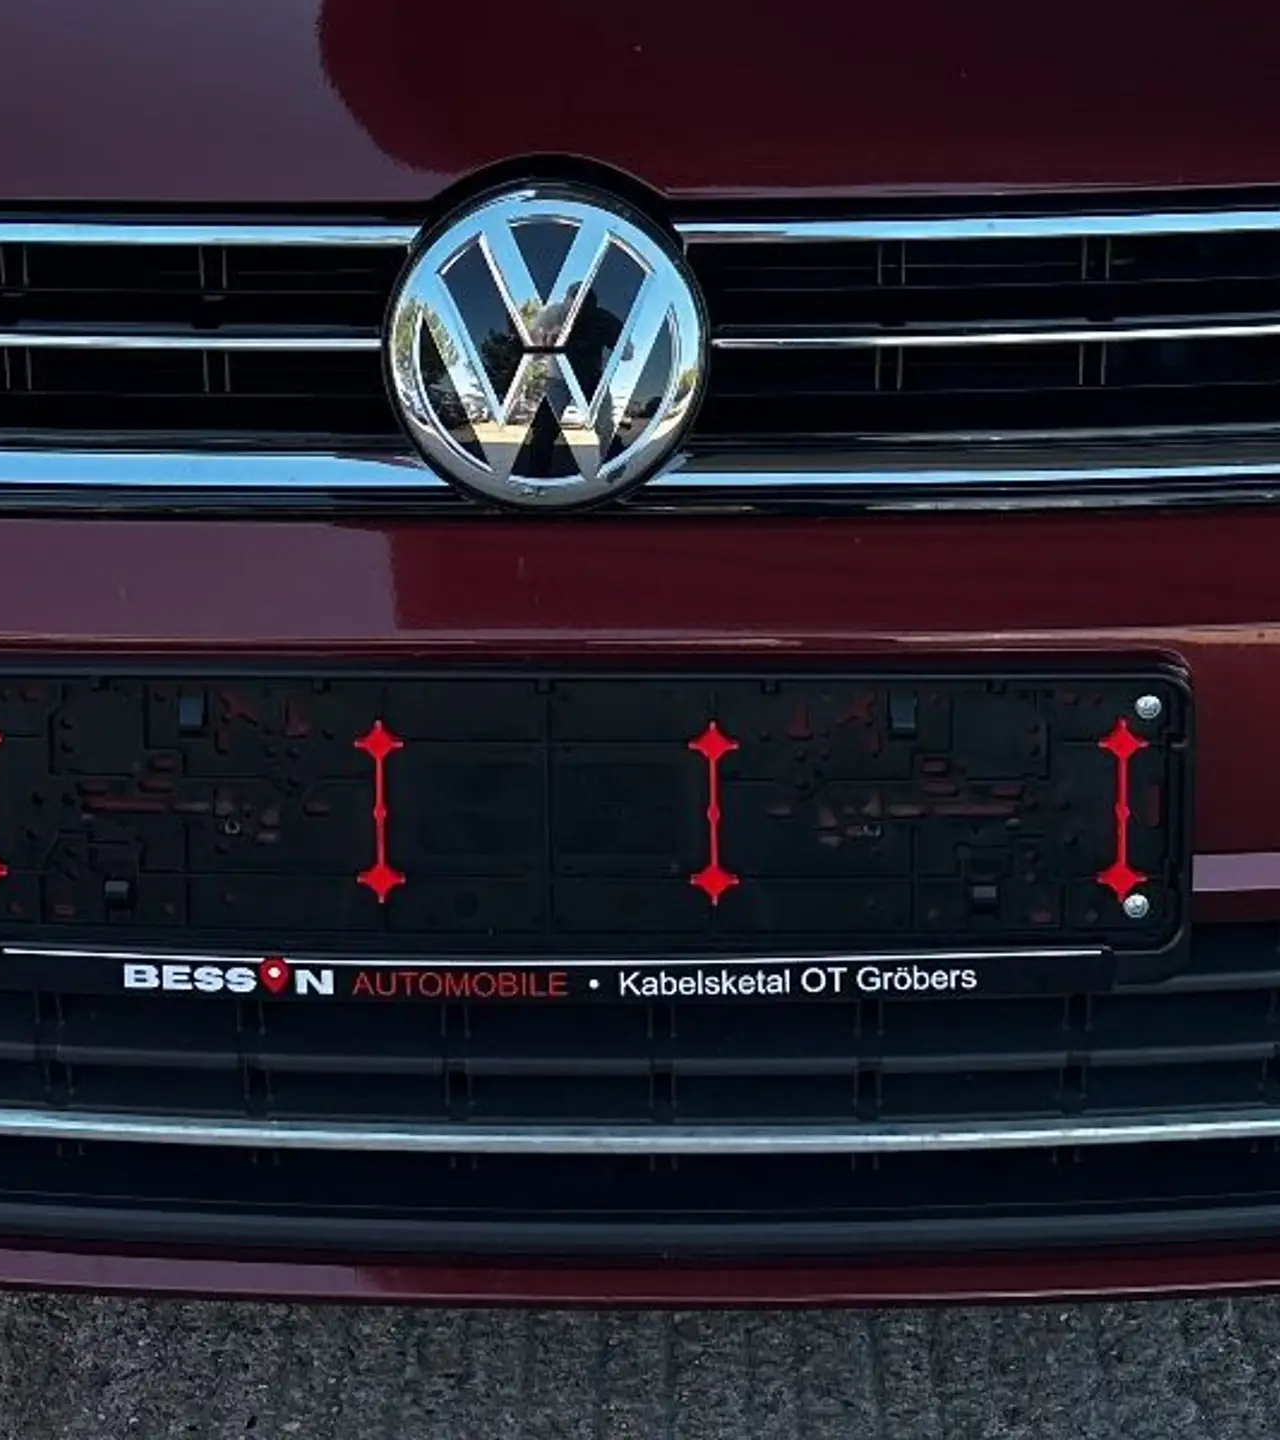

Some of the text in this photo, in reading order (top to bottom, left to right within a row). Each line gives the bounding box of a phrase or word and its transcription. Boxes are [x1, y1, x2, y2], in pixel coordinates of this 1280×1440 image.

[414, 200, 678, 488] VW
[351, 970, 569, 998] AUTOMOBILE
[619, 968, 791, 996] Kabelsketal
[800, 966, 848, 994] OT
[856, 965, 978, 992] Gröbers
